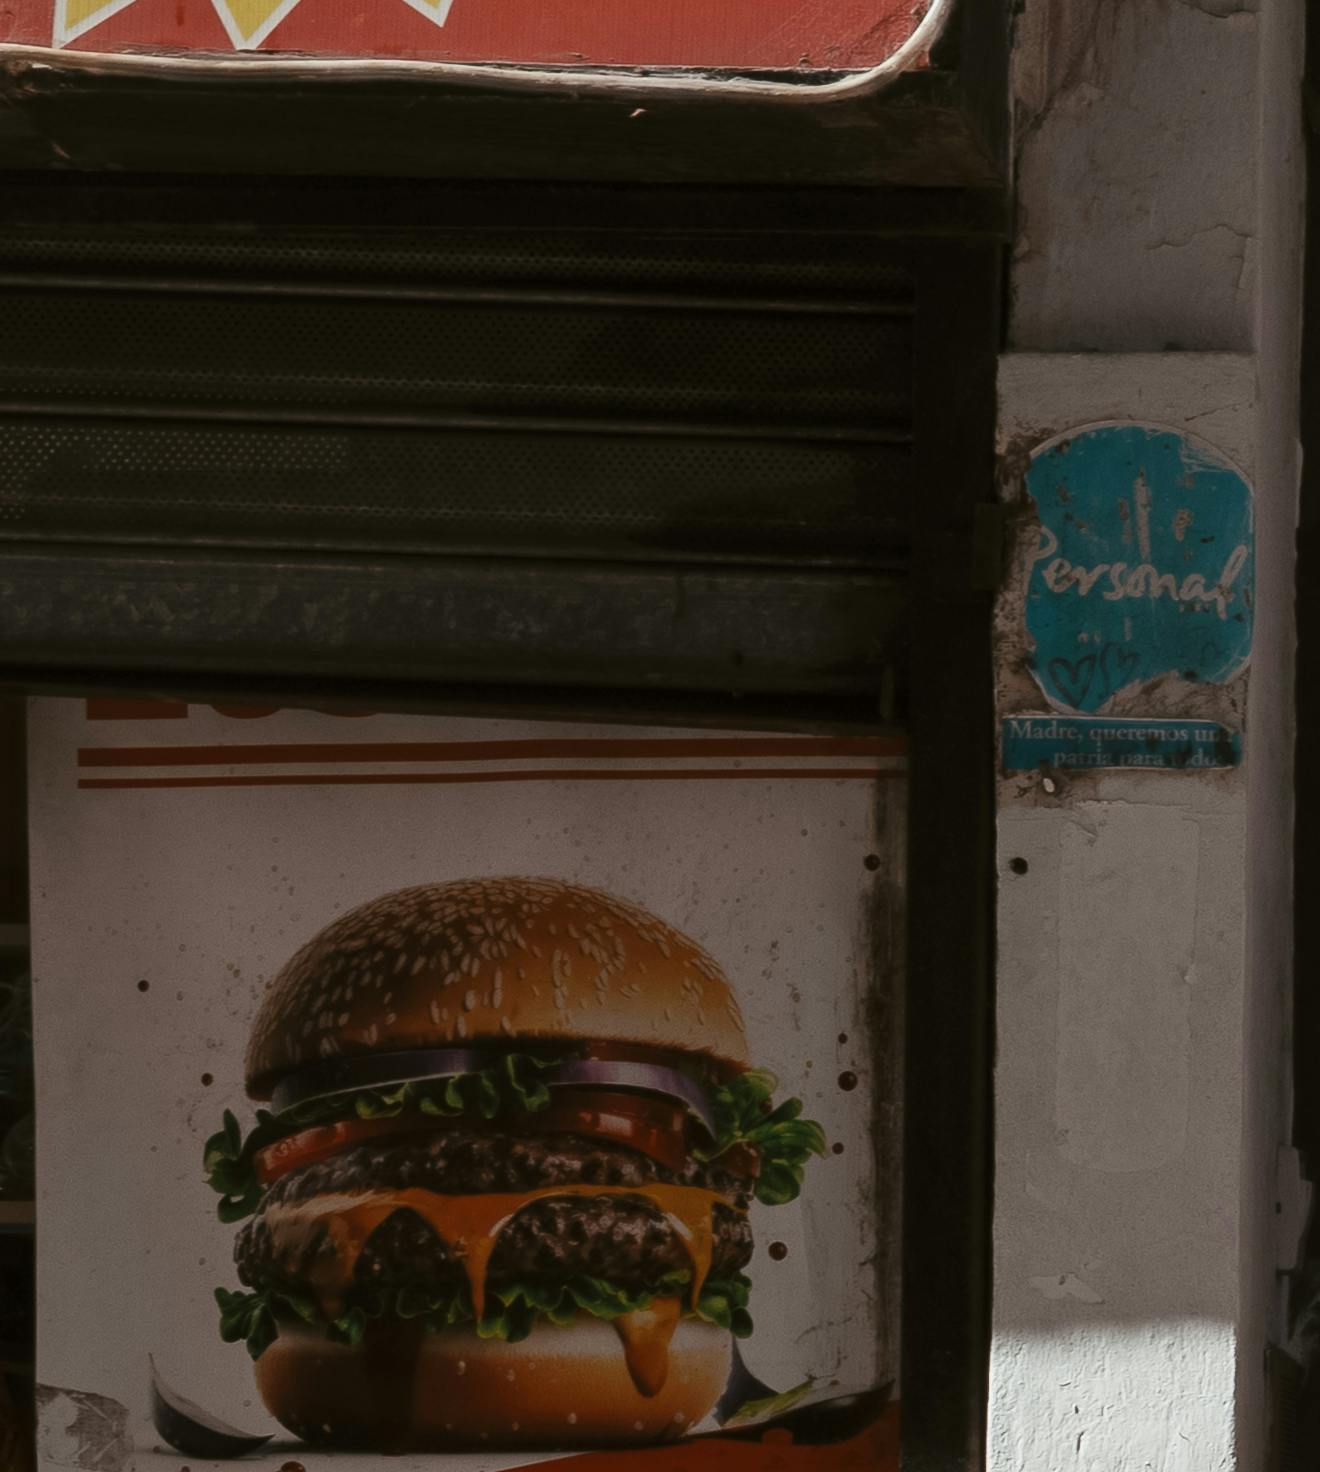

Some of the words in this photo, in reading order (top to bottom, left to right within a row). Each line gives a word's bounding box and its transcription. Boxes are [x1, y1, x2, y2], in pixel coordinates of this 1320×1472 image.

[1024, 526, 1248, 620] Personal
[1009, 720, 1083, 741] Madre,
[1089, 727, 1189, 747] queremos
